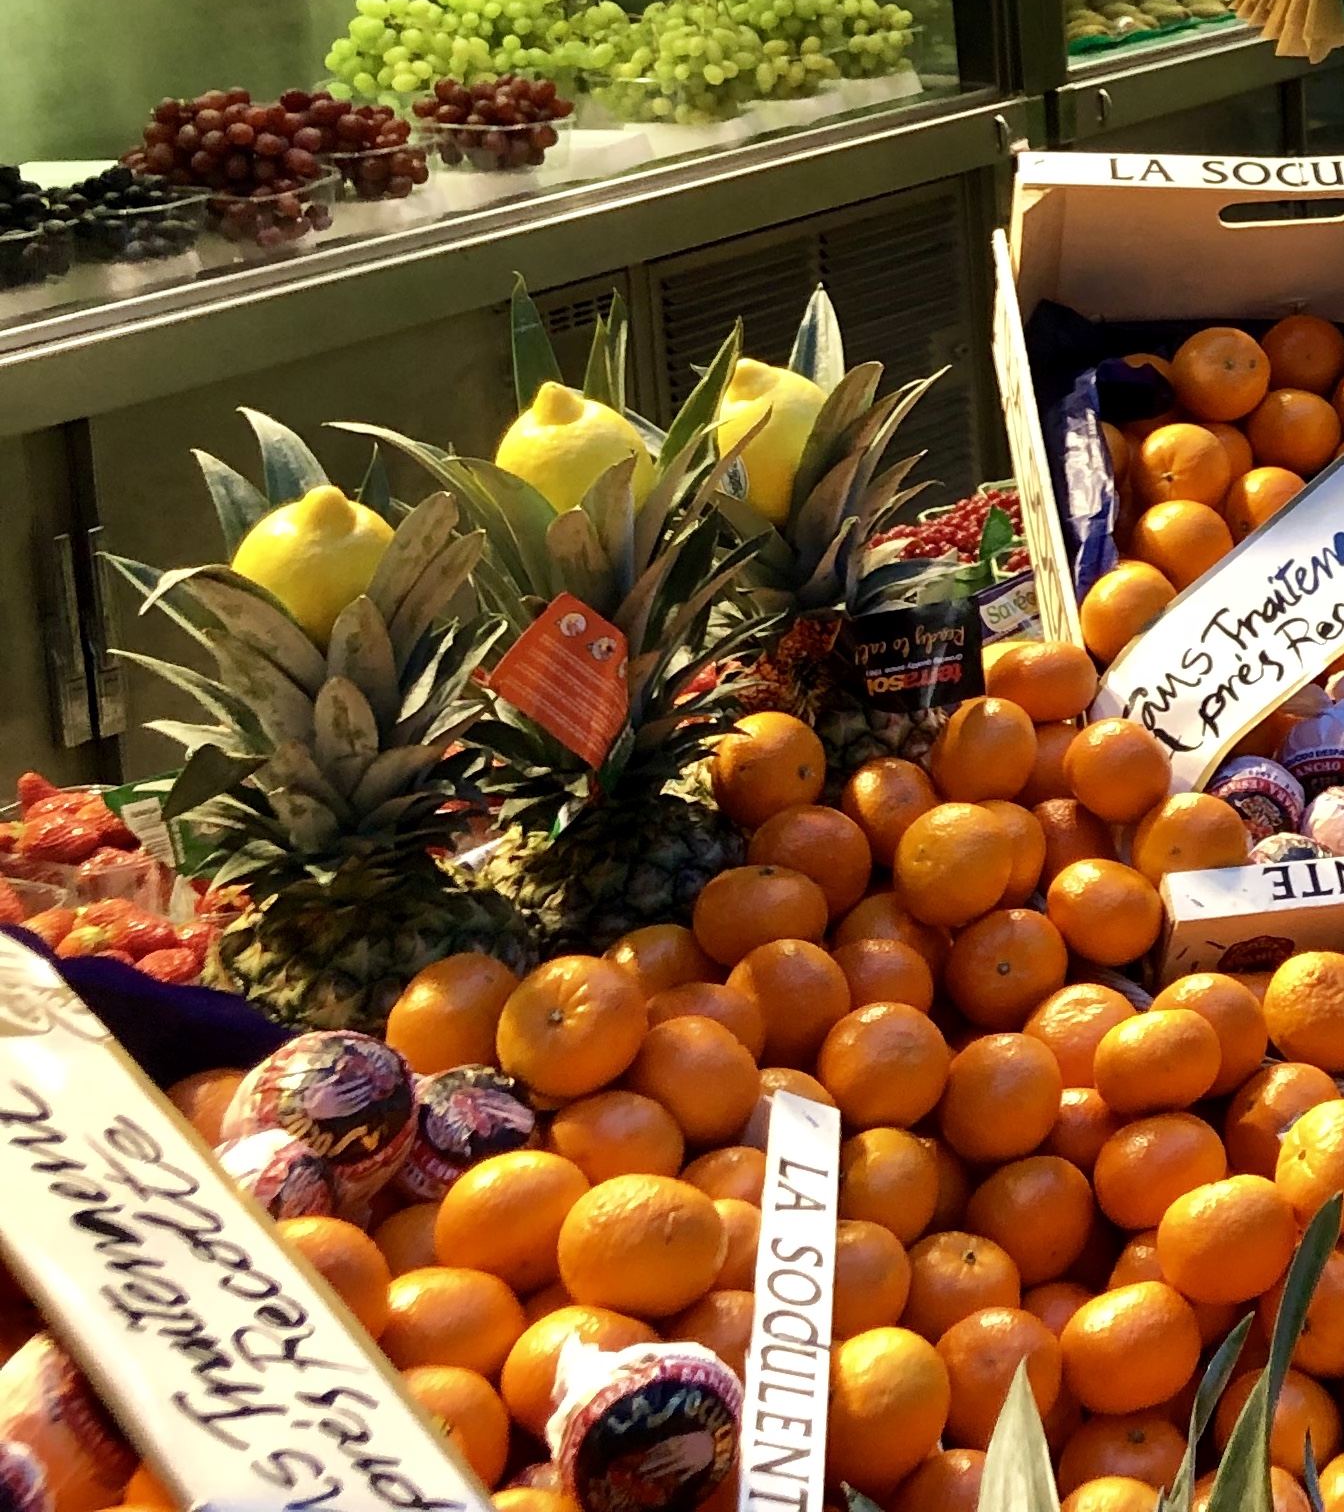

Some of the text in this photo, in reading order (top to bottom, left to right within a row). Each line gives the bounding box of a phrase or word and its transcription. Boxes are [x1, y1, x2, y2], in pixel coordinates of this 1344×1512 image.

[1108, 156, 1175, 183] LA
[893, 636, 911, 658] to
[915, 625, 965, 655] Ready
[865, 662, 964, 698] terrasol
[773, 1155, 830, 1213] LA
